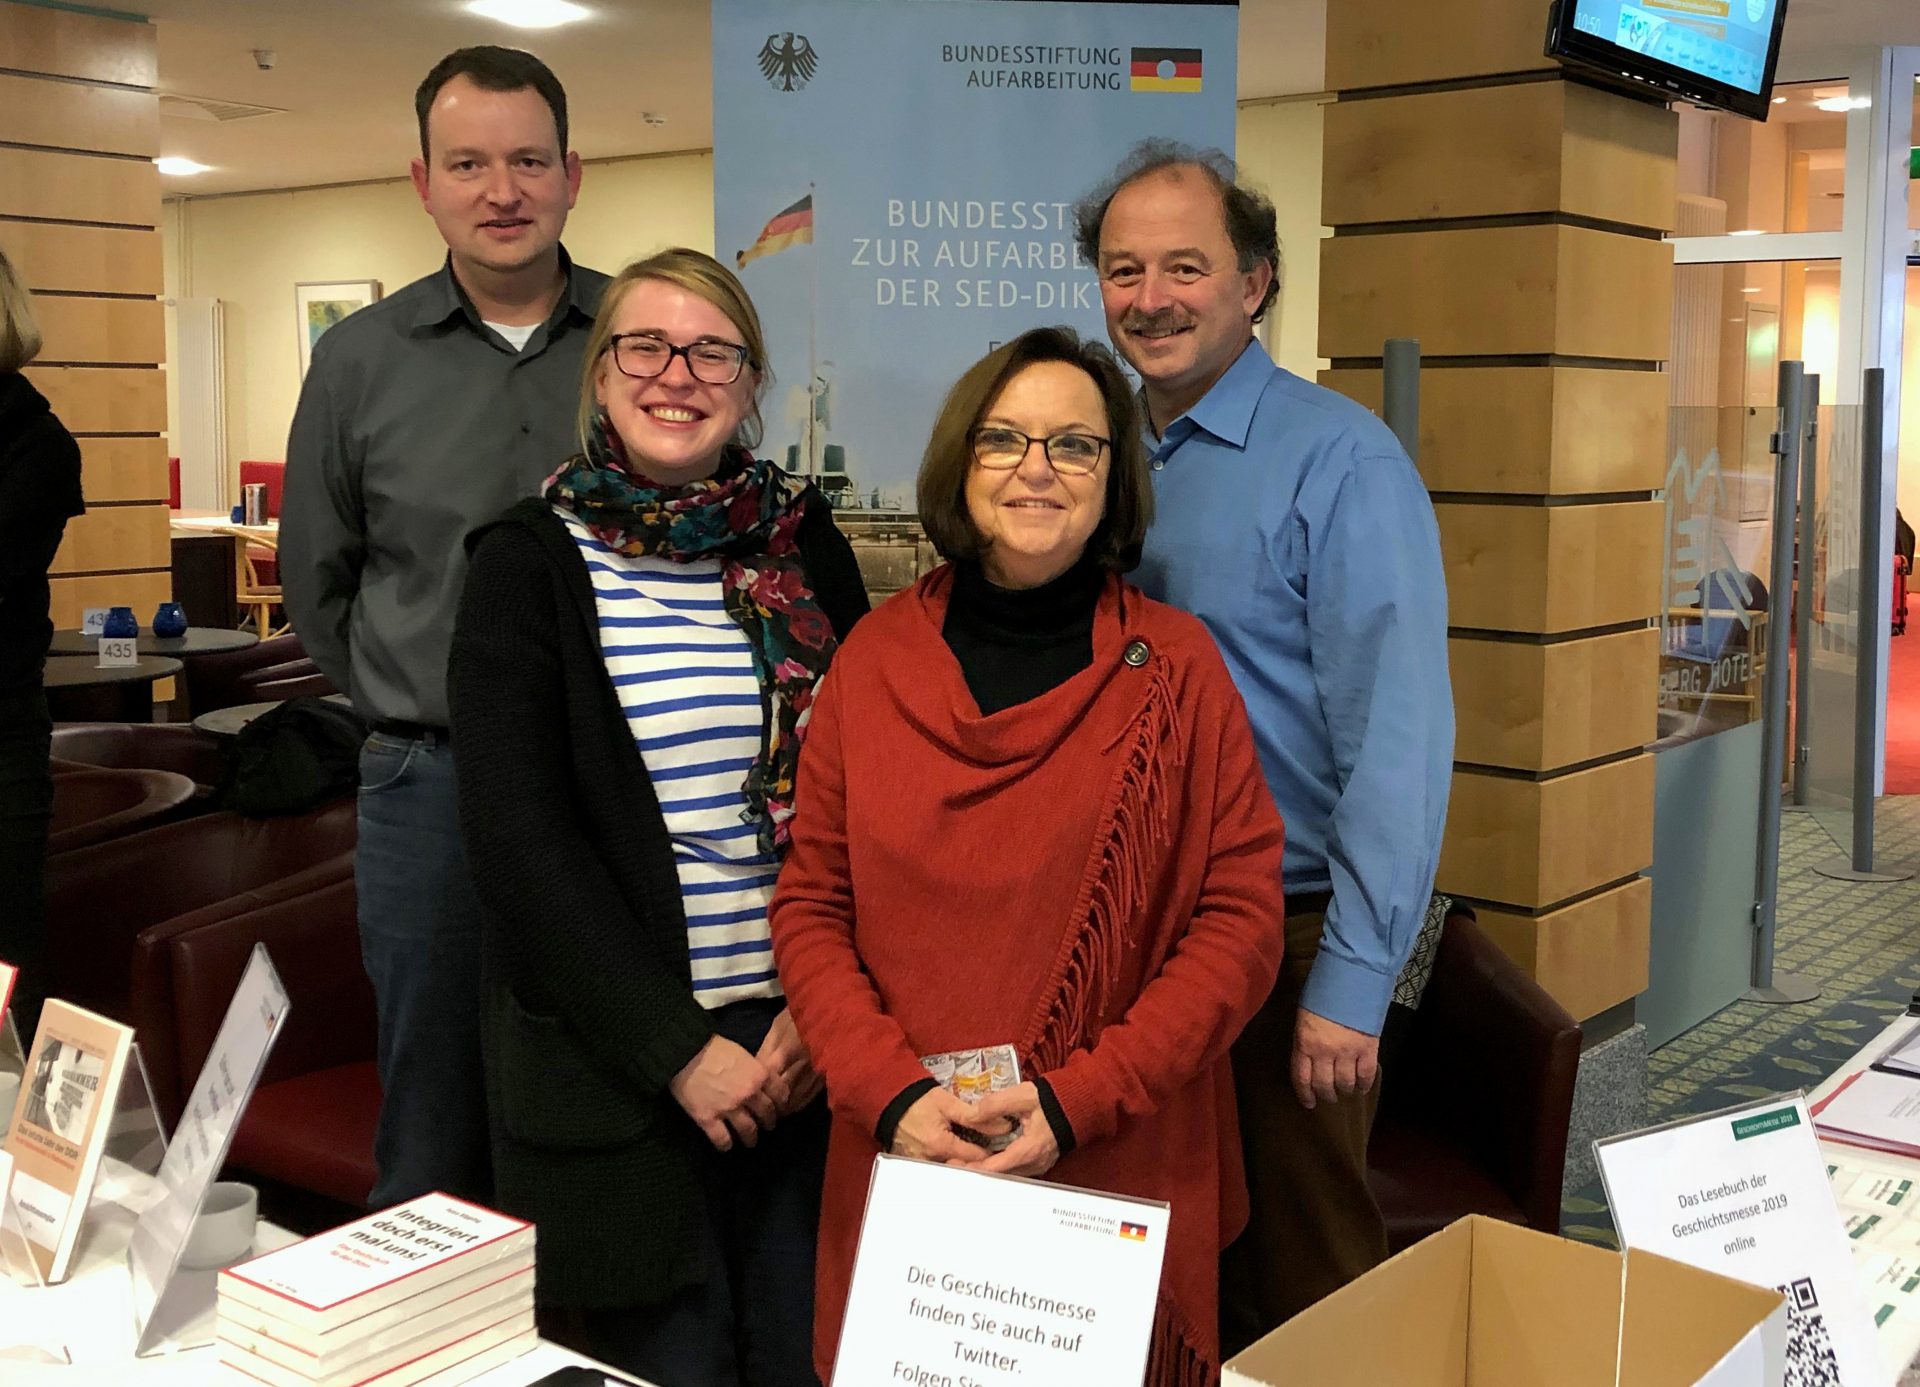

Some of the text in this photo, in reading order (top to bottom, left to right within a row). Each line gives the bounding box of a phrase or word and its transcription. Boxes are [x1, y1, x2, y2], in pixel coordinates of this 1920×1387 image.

[942, 45, 1121, 66] BUNDESSTIFTUNG
[966, 71, 1121, 91] AUFARBEITUNG
[887, 199, 1071, 231] BUNDESST
[851, 237, 1089, 270] ZUR AUFARBE
[876, 277, 1105, 310] DER SED-DIK
[87, 613, 104, 626] 43
[104, 643, 131, 658] 435
[1711, 653, 1757, 689] HOTEL
[1678, 1173, 1768, 1209] Das Lesebuch der
[395, 1208, 480, 1243] Integriert
[1671, 1193, 1788, 1239] Geschichtsmesse 2019
[349, 1230, 391, 1247] mal
[383, 1242, 428, 1261] uns!
[371, 1219, 453, 1252] doch erst
[1723, 1234, 1756, 1256] online
[907, 1266, 1096, 1323] Die Geschichtsmesse
[909, 1298, 1084, 1353] finden Sie auch auf
[893, 1361, 952, 1387] Folgen
[954, 1341, 1023, 1375] Twitter.
